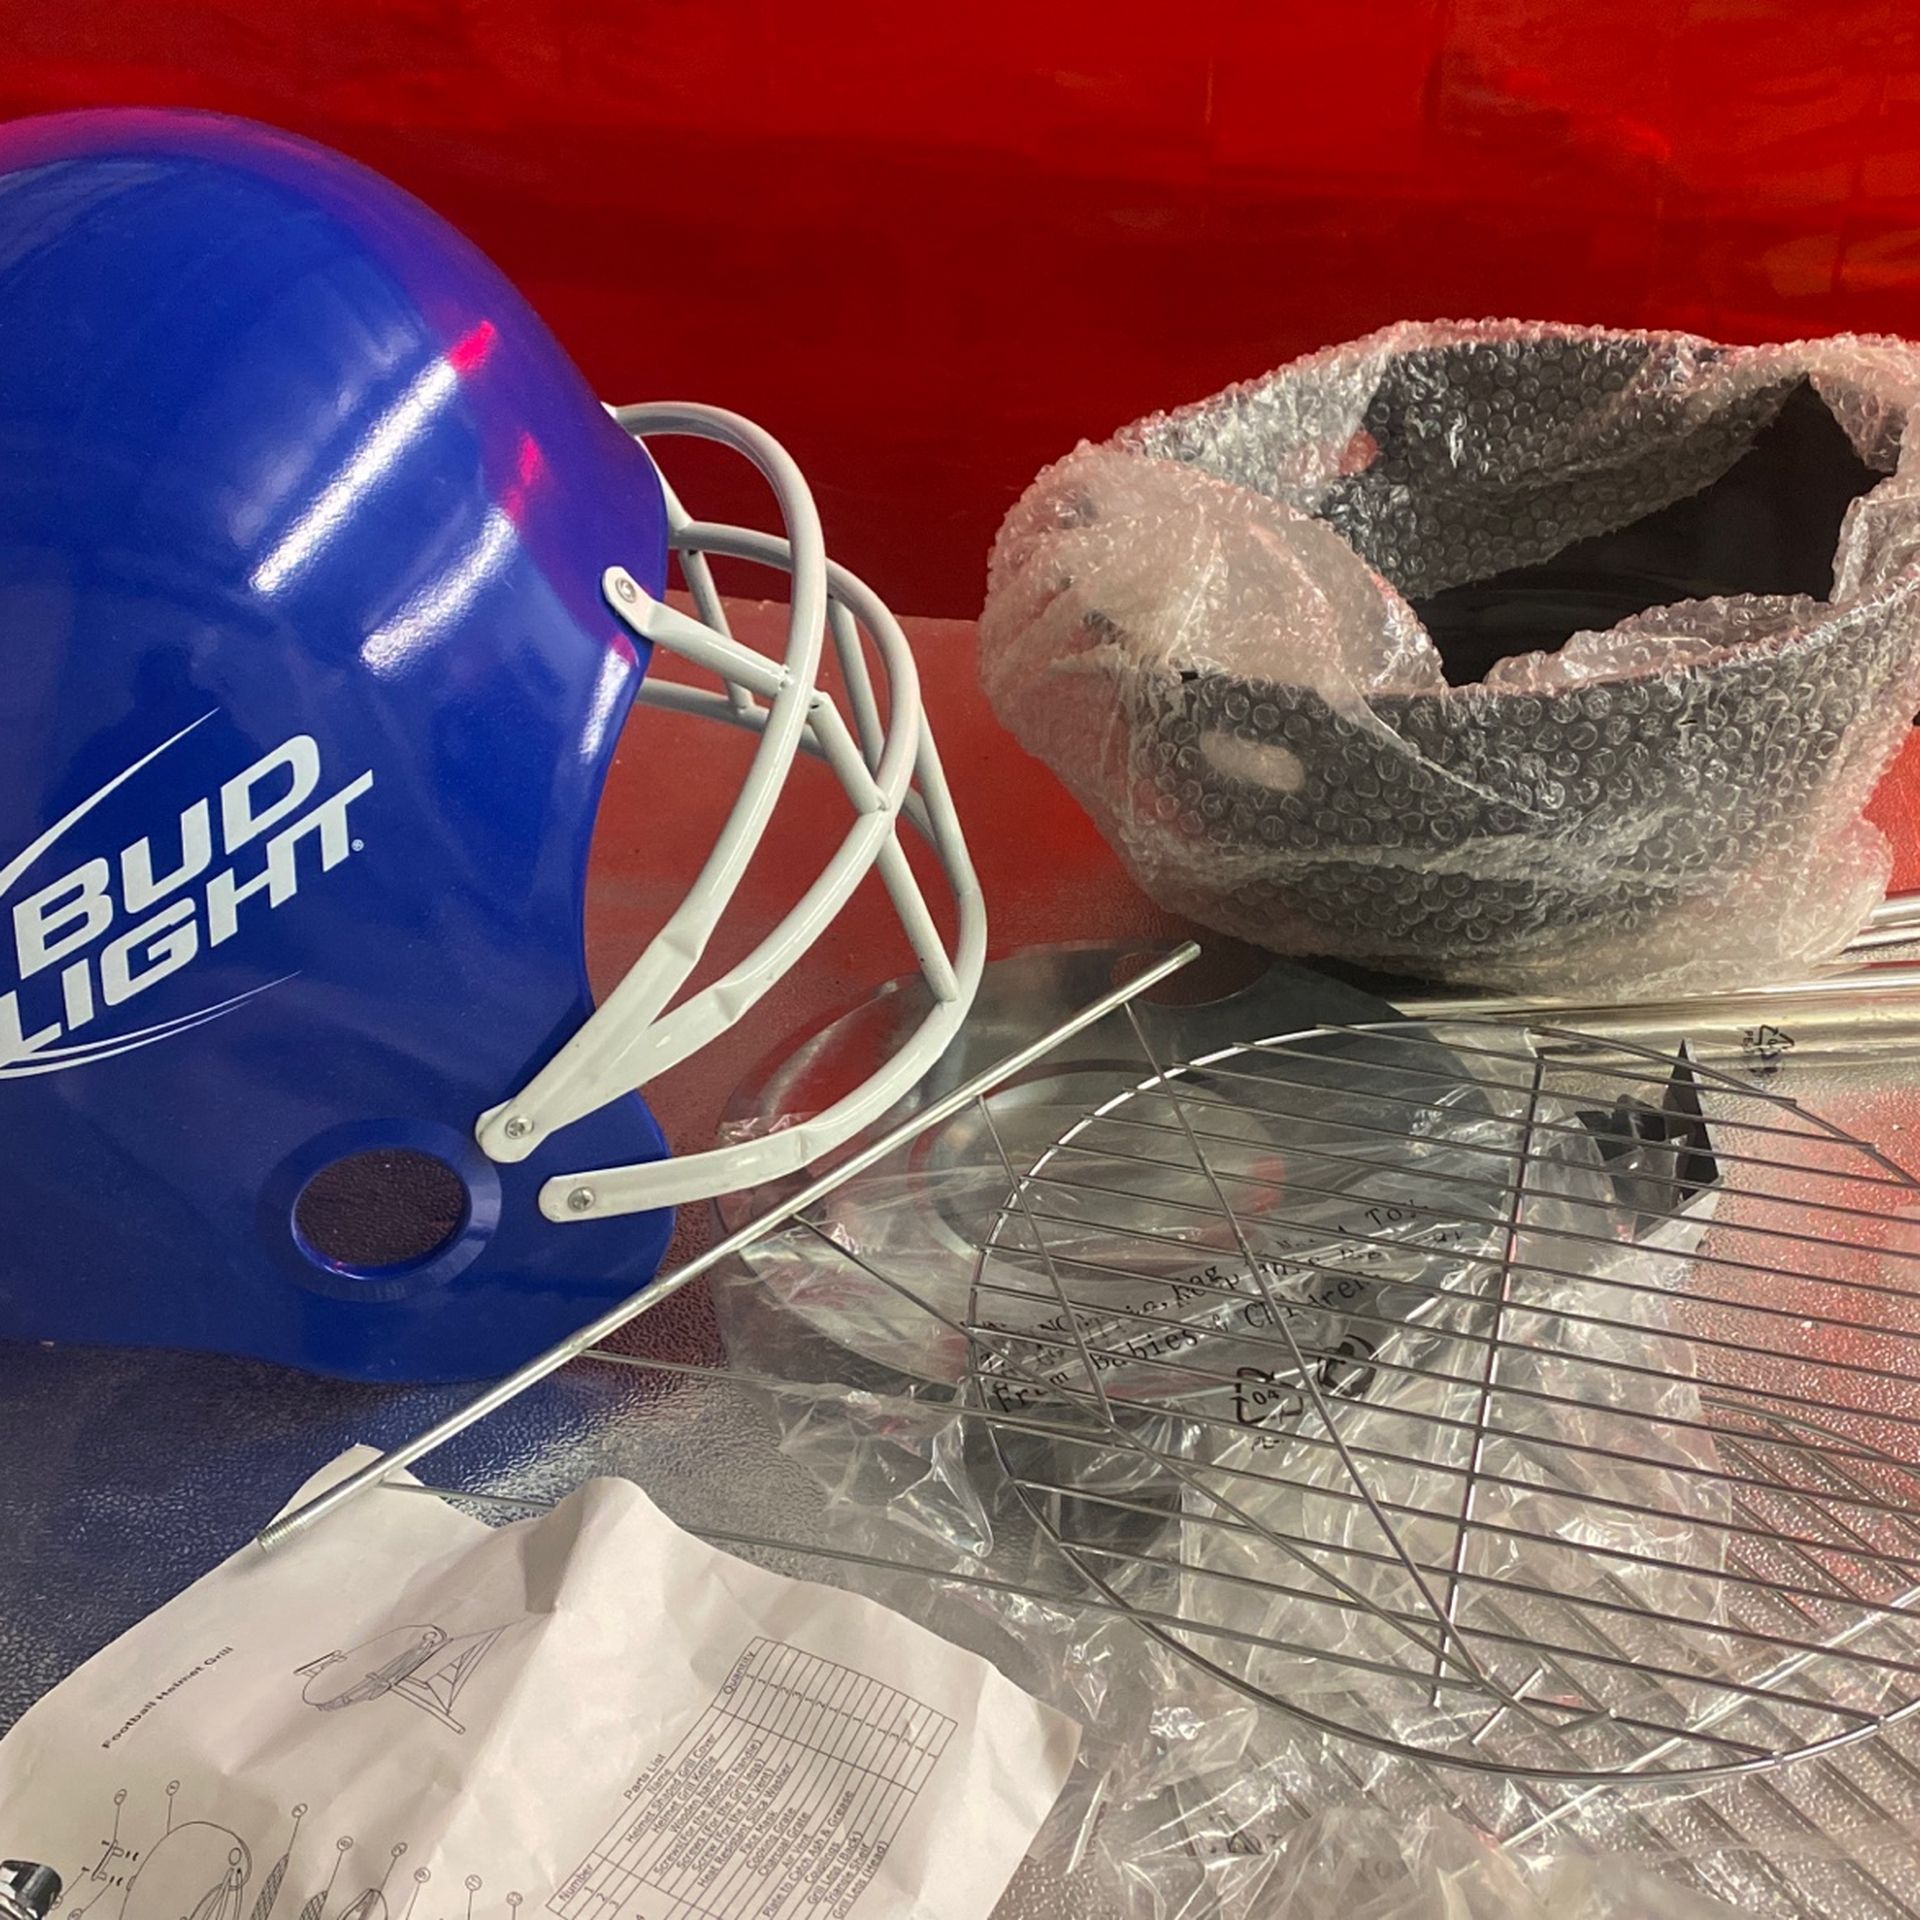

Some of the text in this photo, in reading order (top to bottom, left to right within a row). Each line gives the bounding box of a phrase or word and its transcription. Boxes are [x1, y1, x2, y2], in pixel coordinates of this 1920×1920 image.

[13, 734, 320, 981] BUD
[0, 769, 374, 1069] LIGHT
[1090, 1330, 1198, 1370] Babies
[1252, 1390, 1280, 1405] 04
[723, 1650, 756, 1696] Quantity
[102, 1646, 234, 1749] Football Helmet Grill
[623, 1753, 667, 1800] Parts List
[646, 1768, 673, 1795] Name
[558, 1863, 594, 1902] Number
